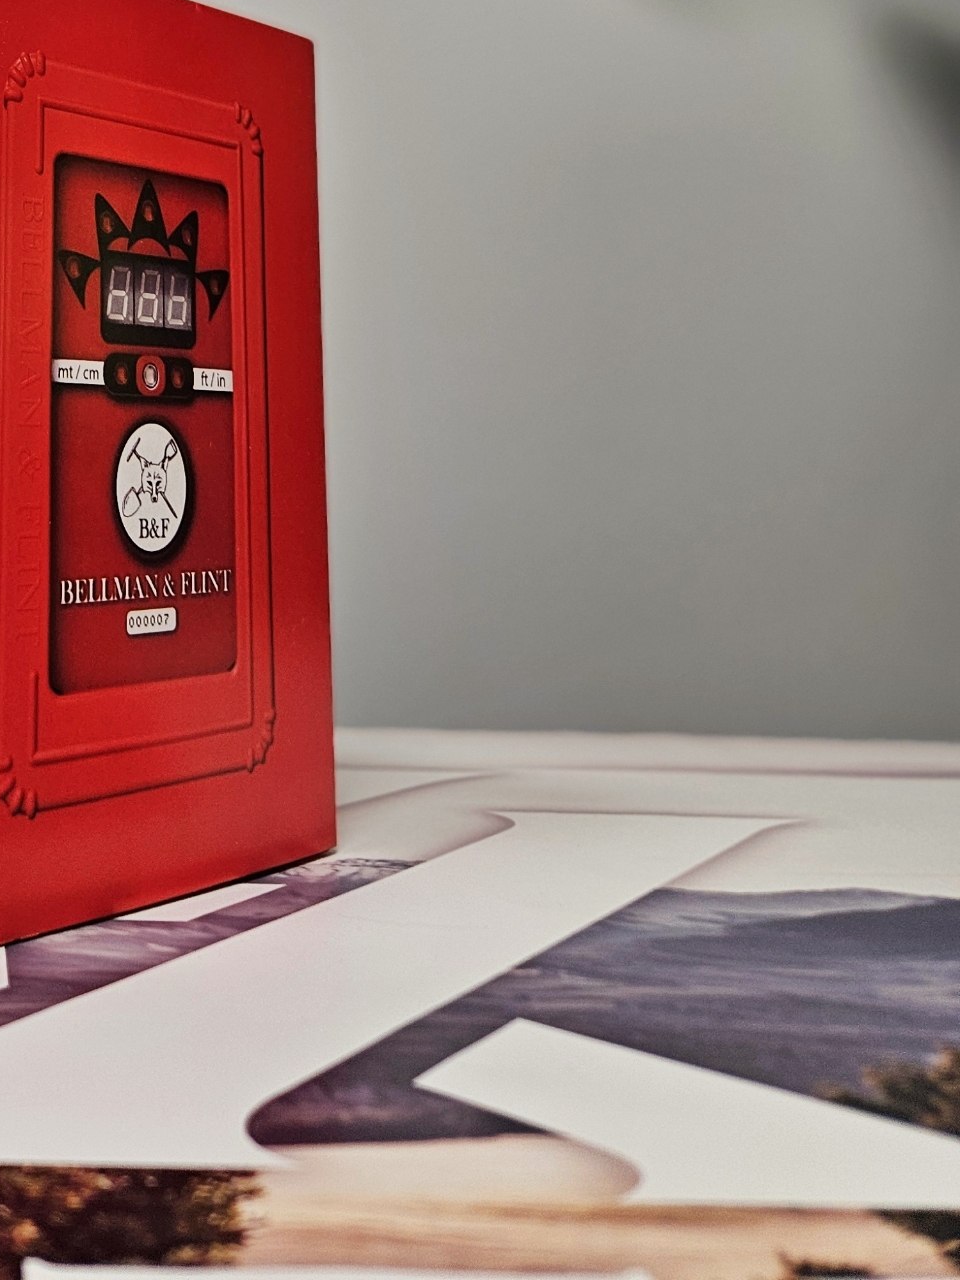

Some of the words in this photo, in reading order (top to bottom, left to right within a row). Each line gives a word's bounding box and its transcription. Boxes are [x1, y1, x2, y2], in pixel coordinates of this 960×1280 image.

[139, 518, 170, 539] B&F
[60, 573, 158, 605] BELLMAN
[162, 573, 176, 597] &
[181, 569, 232, 595] FLINT
[128, 613, 171, 628] 000007
